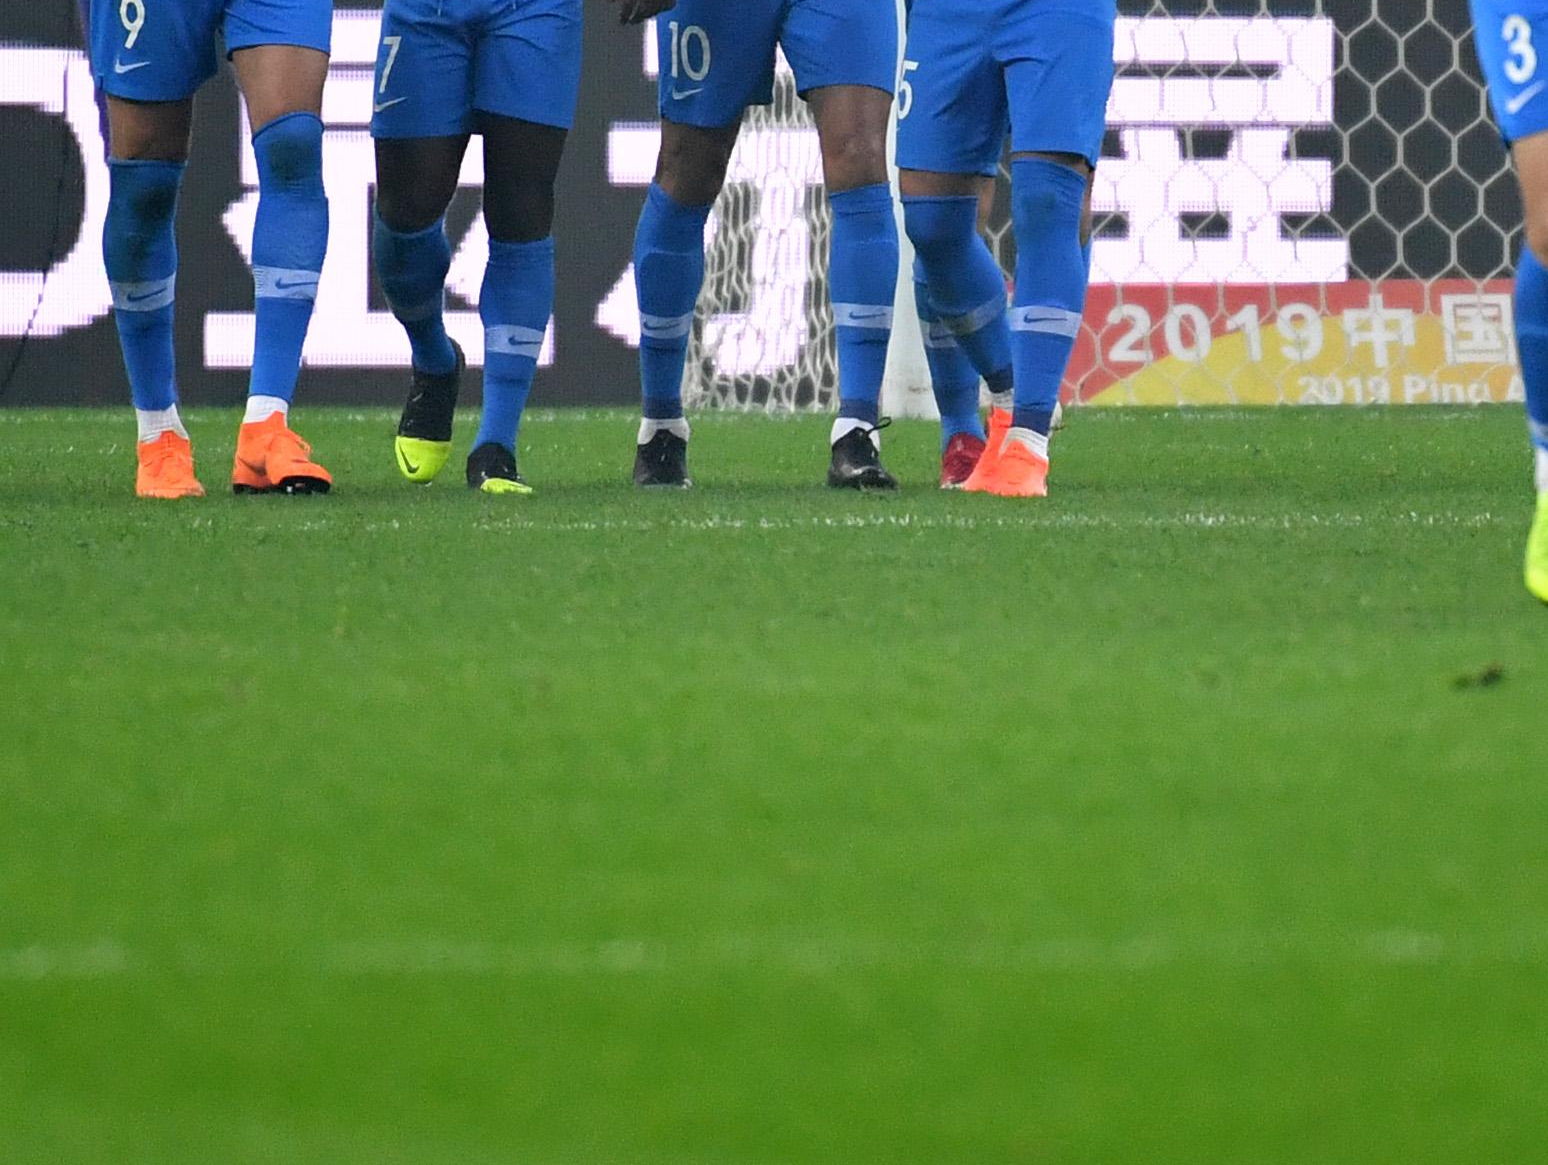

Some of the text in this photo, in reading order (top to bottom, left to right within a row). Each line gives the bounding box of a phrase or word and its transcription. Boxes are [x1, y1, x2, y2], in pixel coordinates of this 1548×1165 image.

[378, 35, 402, 94] 7
[668, 20, 711, 81] 10
[1502, 14, 1538, 84] 3
